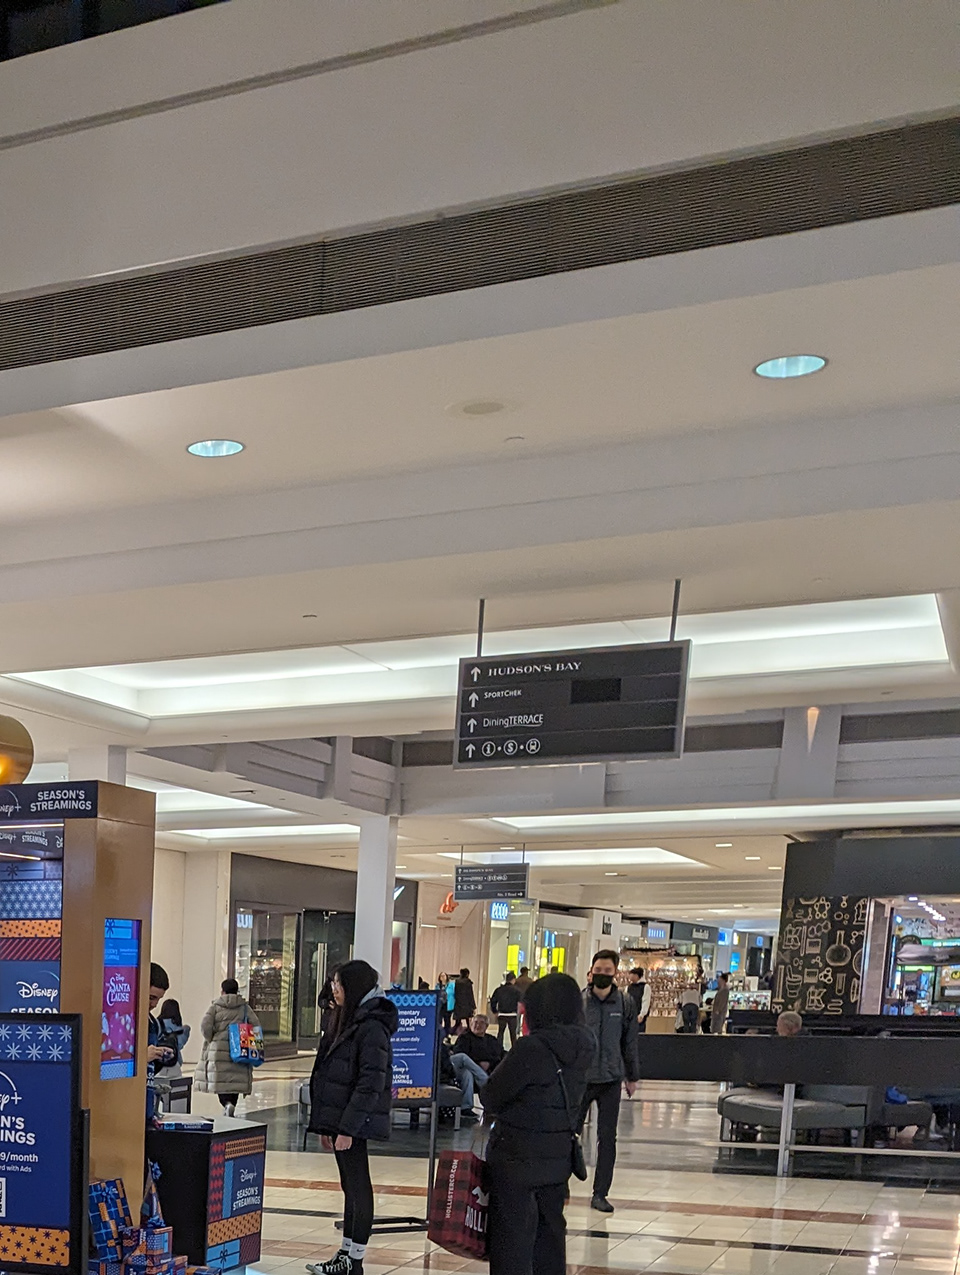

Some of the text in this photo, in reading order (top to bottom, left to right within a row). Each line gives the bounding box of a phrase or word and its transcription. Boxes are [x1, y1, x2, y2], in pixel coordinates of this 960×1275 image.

[488, 661, 582, 677] HUDSON'S BAY
[37, 790, 86, 801] SEASON'S
[30, 800, 92, 812] STREAMINGS
[110, 977, 131, 992] SANTA
[107, 990, 129, 1006] CLAUSE
[236, 1186, 259, 1200] SEASON'S
[232, 1196, 261, 1211] STREAMINGS
